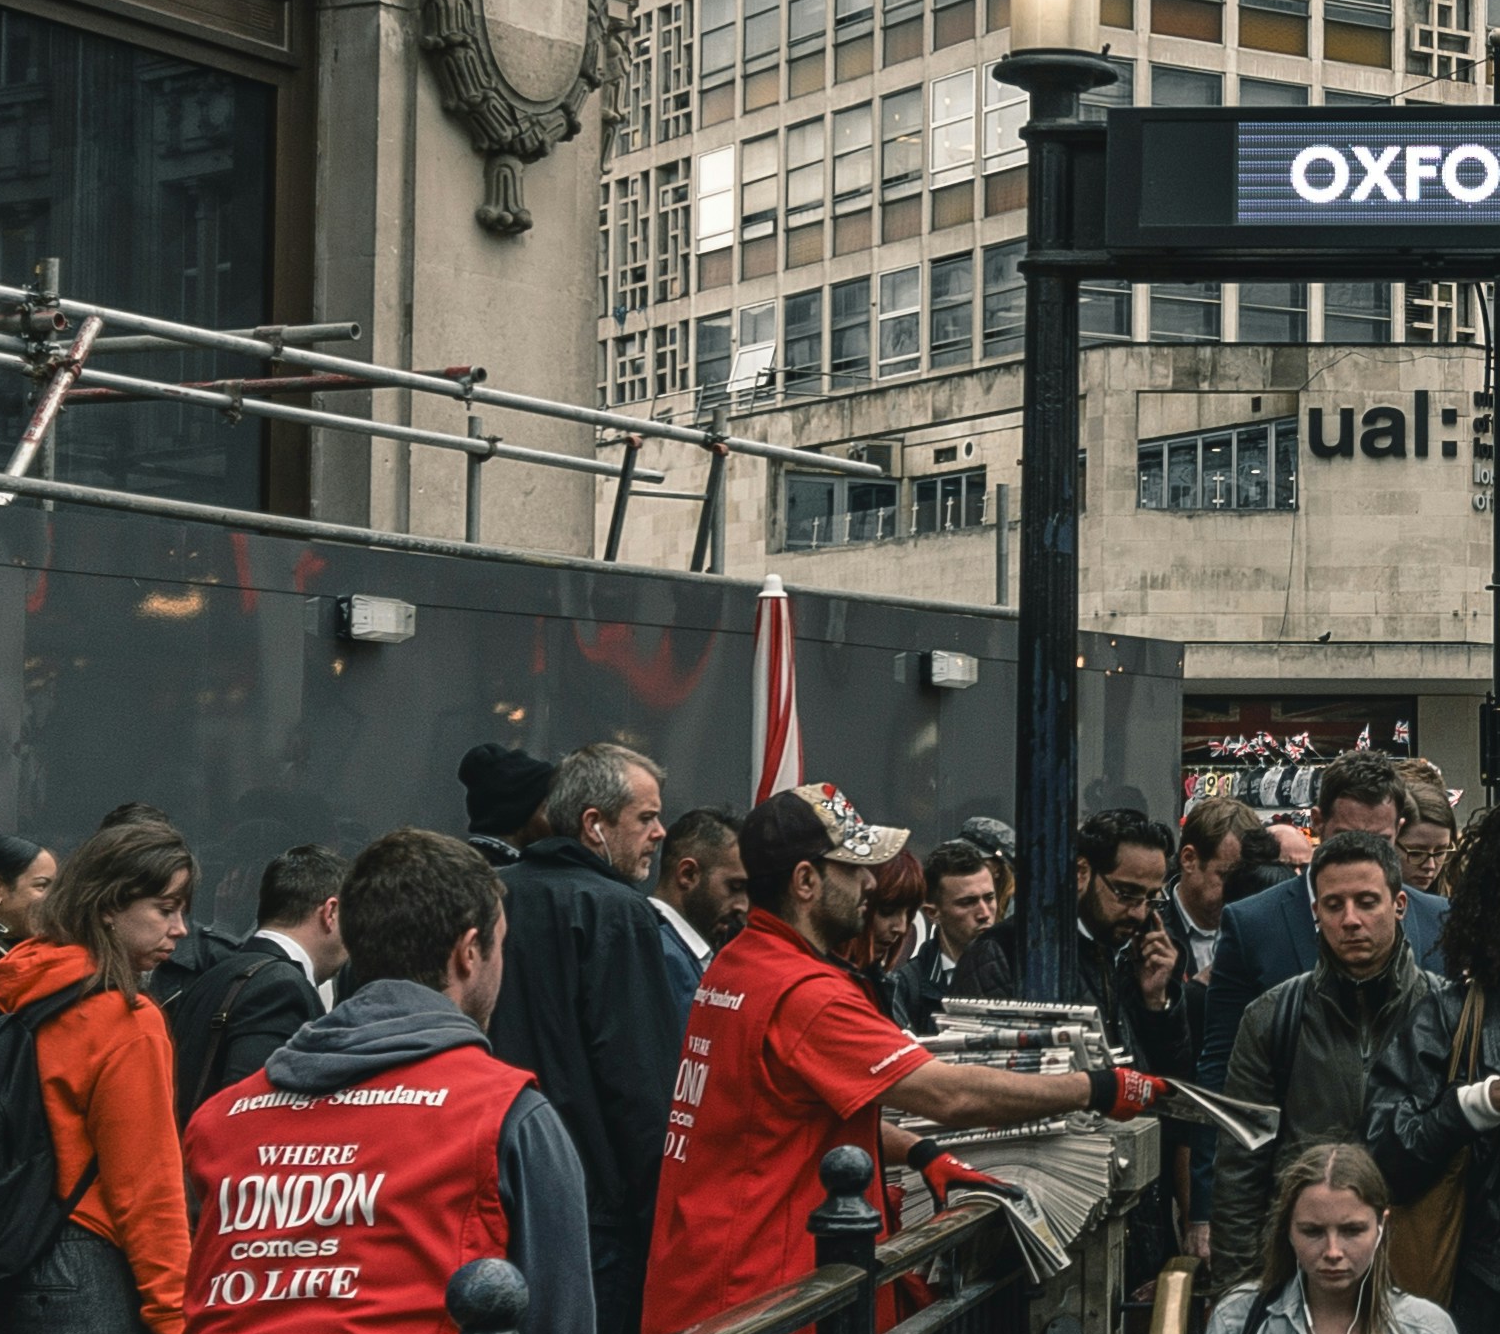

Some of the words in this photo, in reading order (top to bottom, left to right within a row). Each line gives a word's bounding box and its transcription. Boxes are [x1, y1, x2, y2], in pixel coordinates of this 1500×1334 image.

[1308, 389, 1458, 458] ual:
[328, 1084, 449, 1107] Standard
[257, 1143, 359, 1166] WHERE
[218, 1172, 385, 1235] LONDON
[231, 1238, 339, 1260] comes
[204, 1269, 255, 1308] TO
[257, 1266, 360, 1302] LIFE
